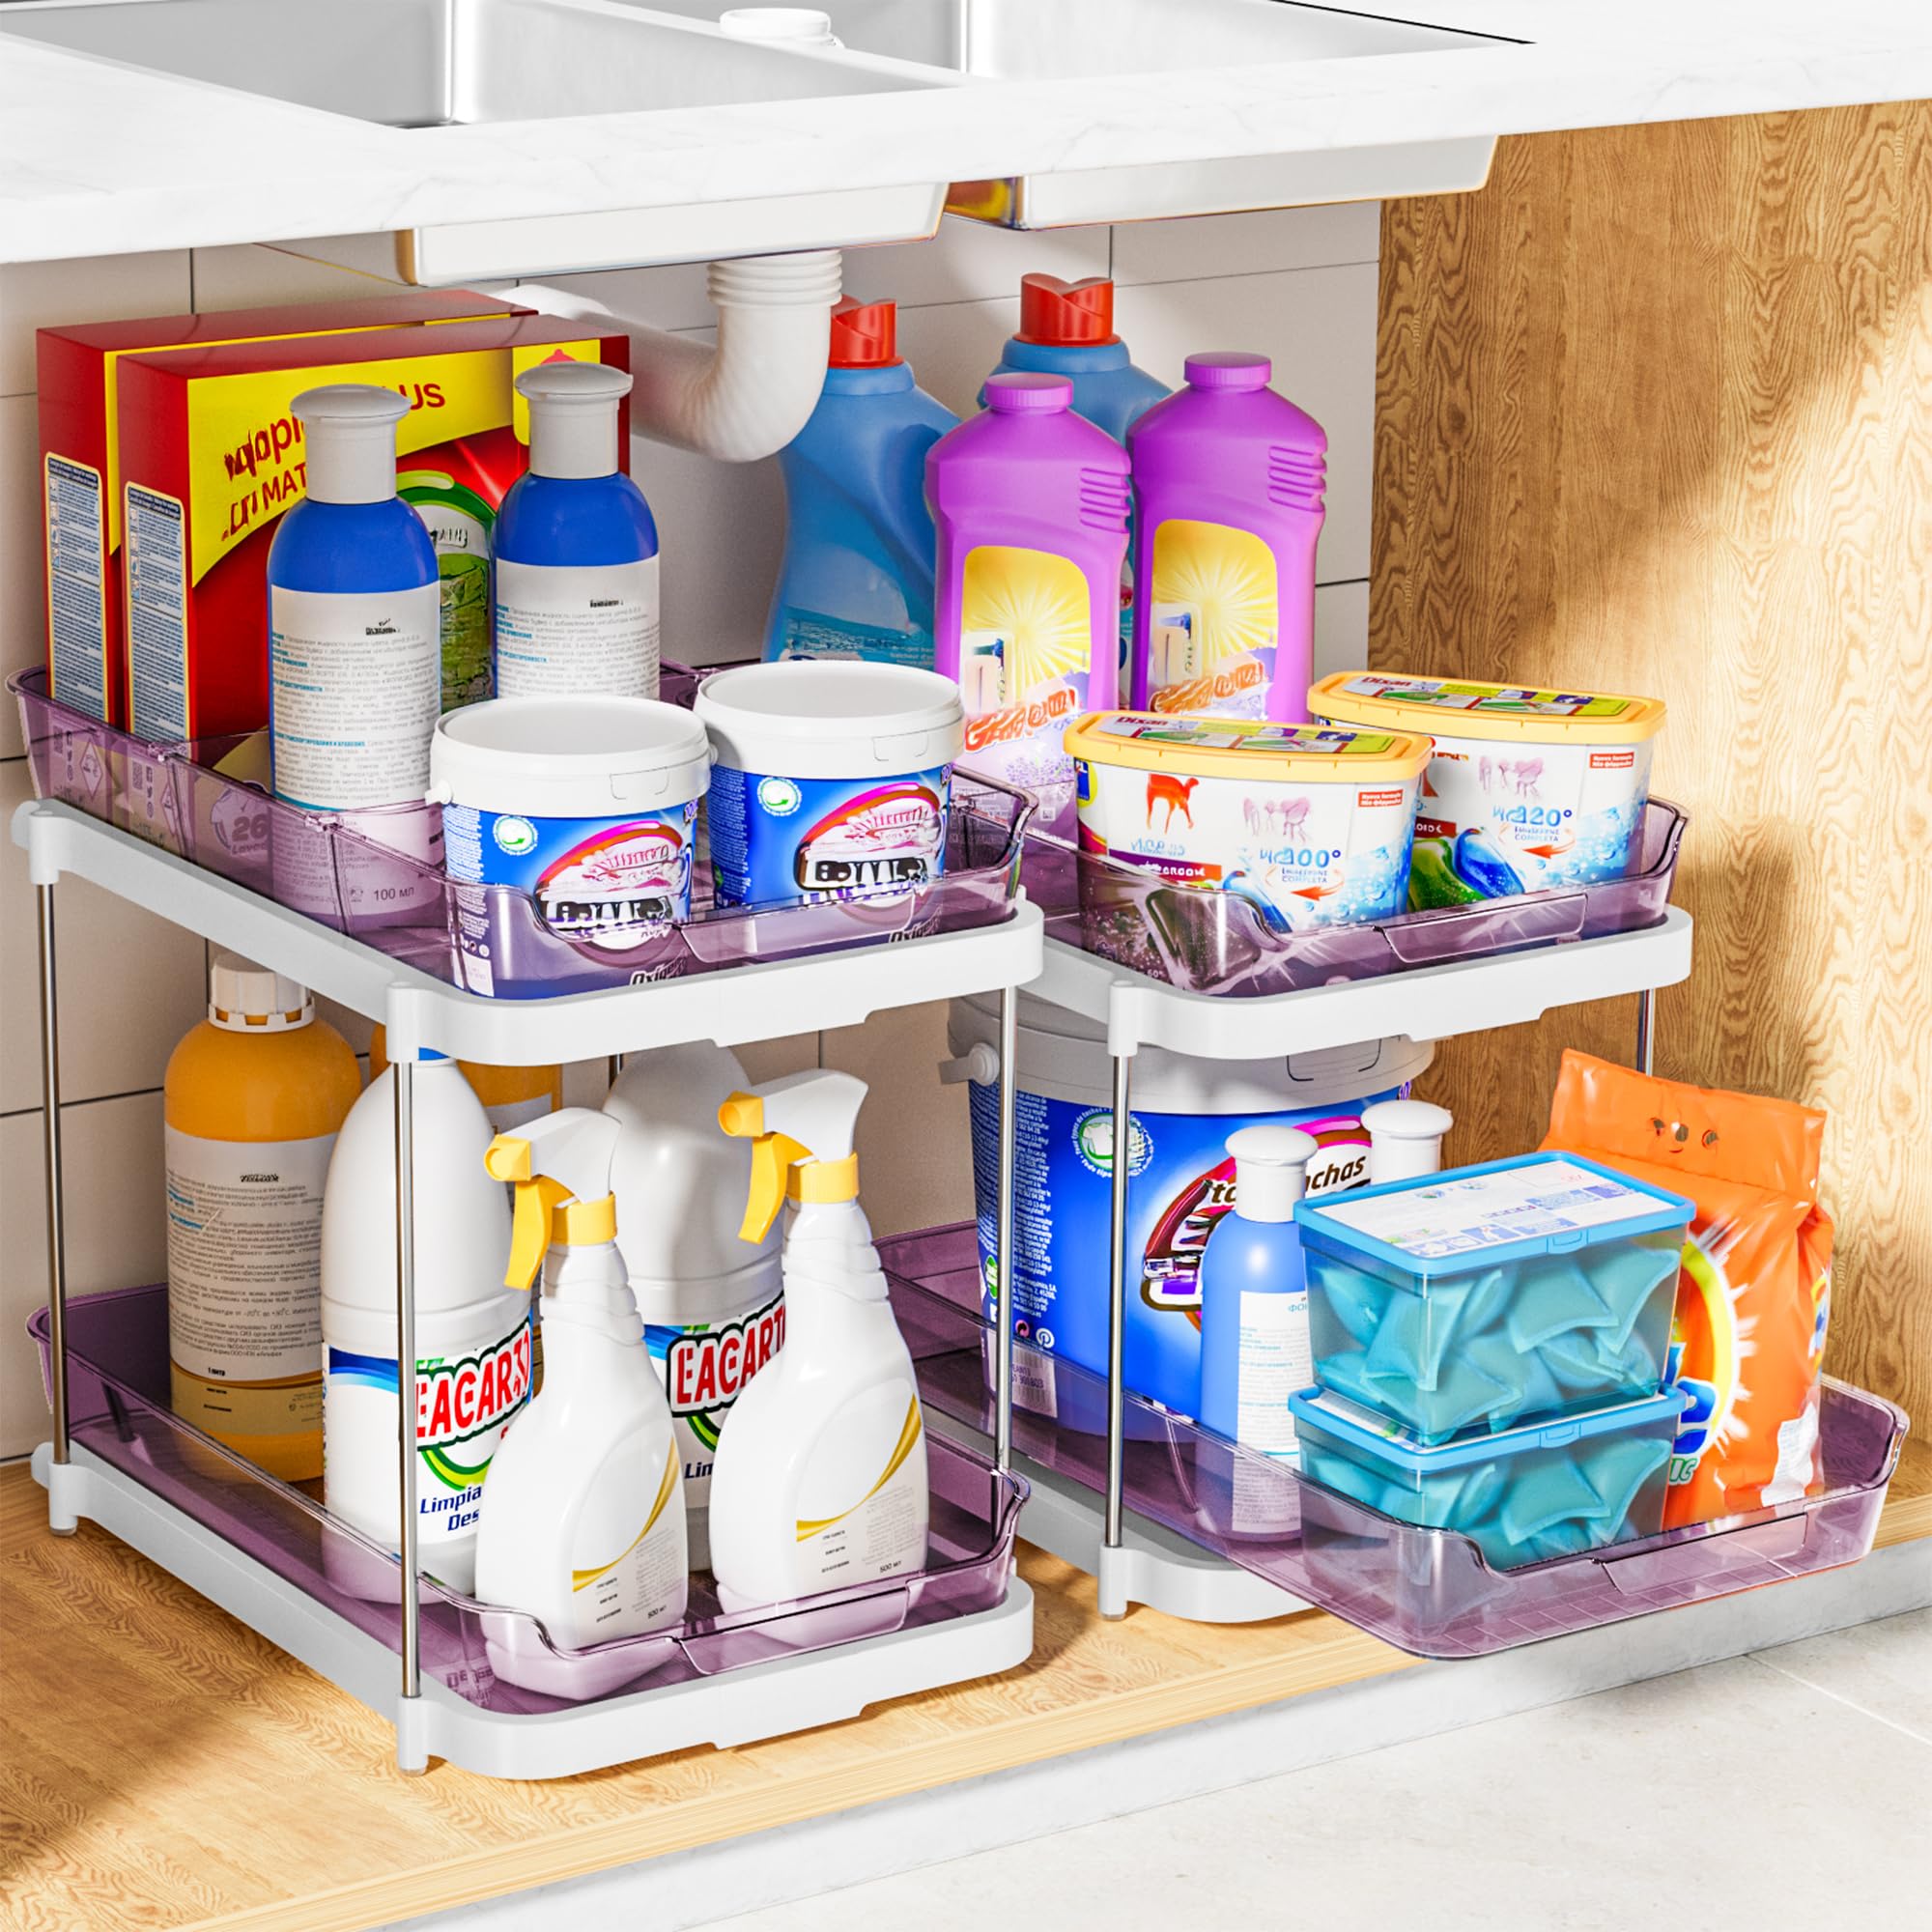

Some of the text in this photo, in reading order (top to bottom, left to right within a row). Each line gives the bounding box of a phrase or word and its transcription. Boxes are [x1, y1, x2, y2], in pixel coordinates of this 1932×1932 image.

[373, 888, 396, 901] 100
[419, 1485, 483, 1515] Limpia
[446, 1508, 480, 1532] Des
